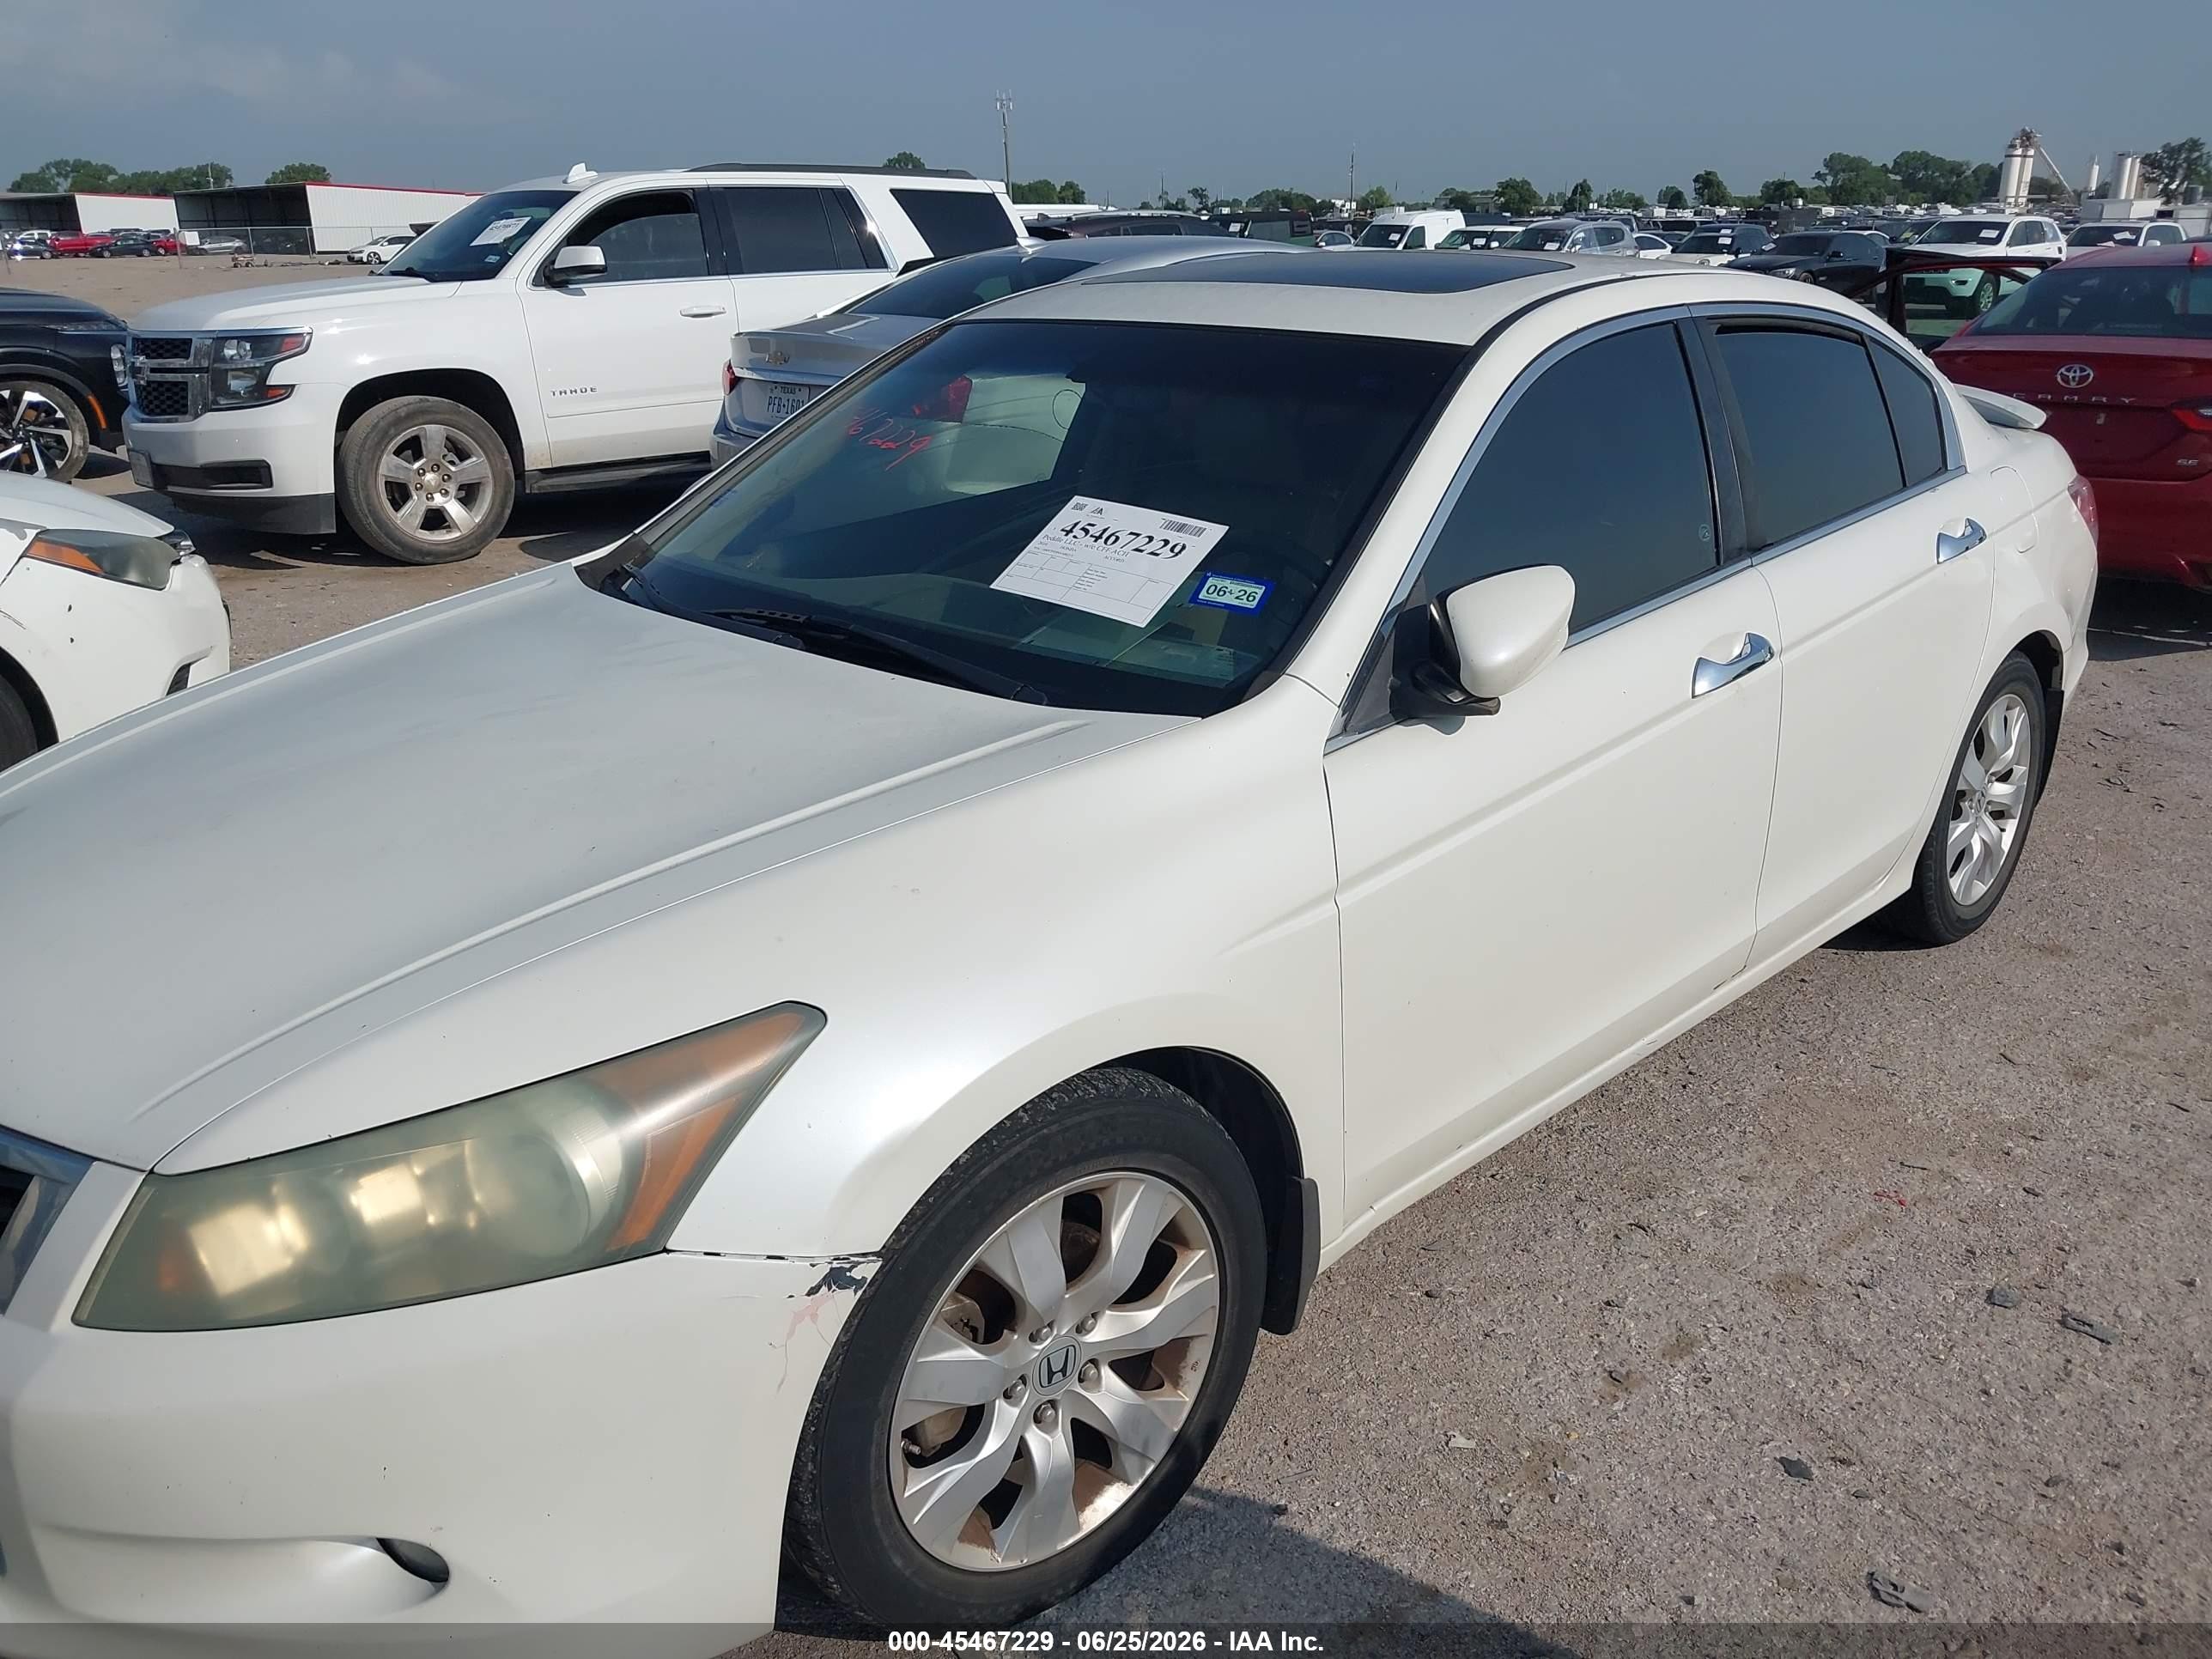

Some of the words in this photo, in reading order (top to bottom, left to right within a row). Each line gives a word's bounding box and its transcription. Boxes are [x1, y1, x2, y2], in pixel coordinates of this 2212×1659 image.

[550, 386, 598, 397] TAHOE
[2012, 392, 2136, 404] CAMRY
[1060, 520, 1187, 560] 45467229
[1064, 538, 1081, 546] LLC
